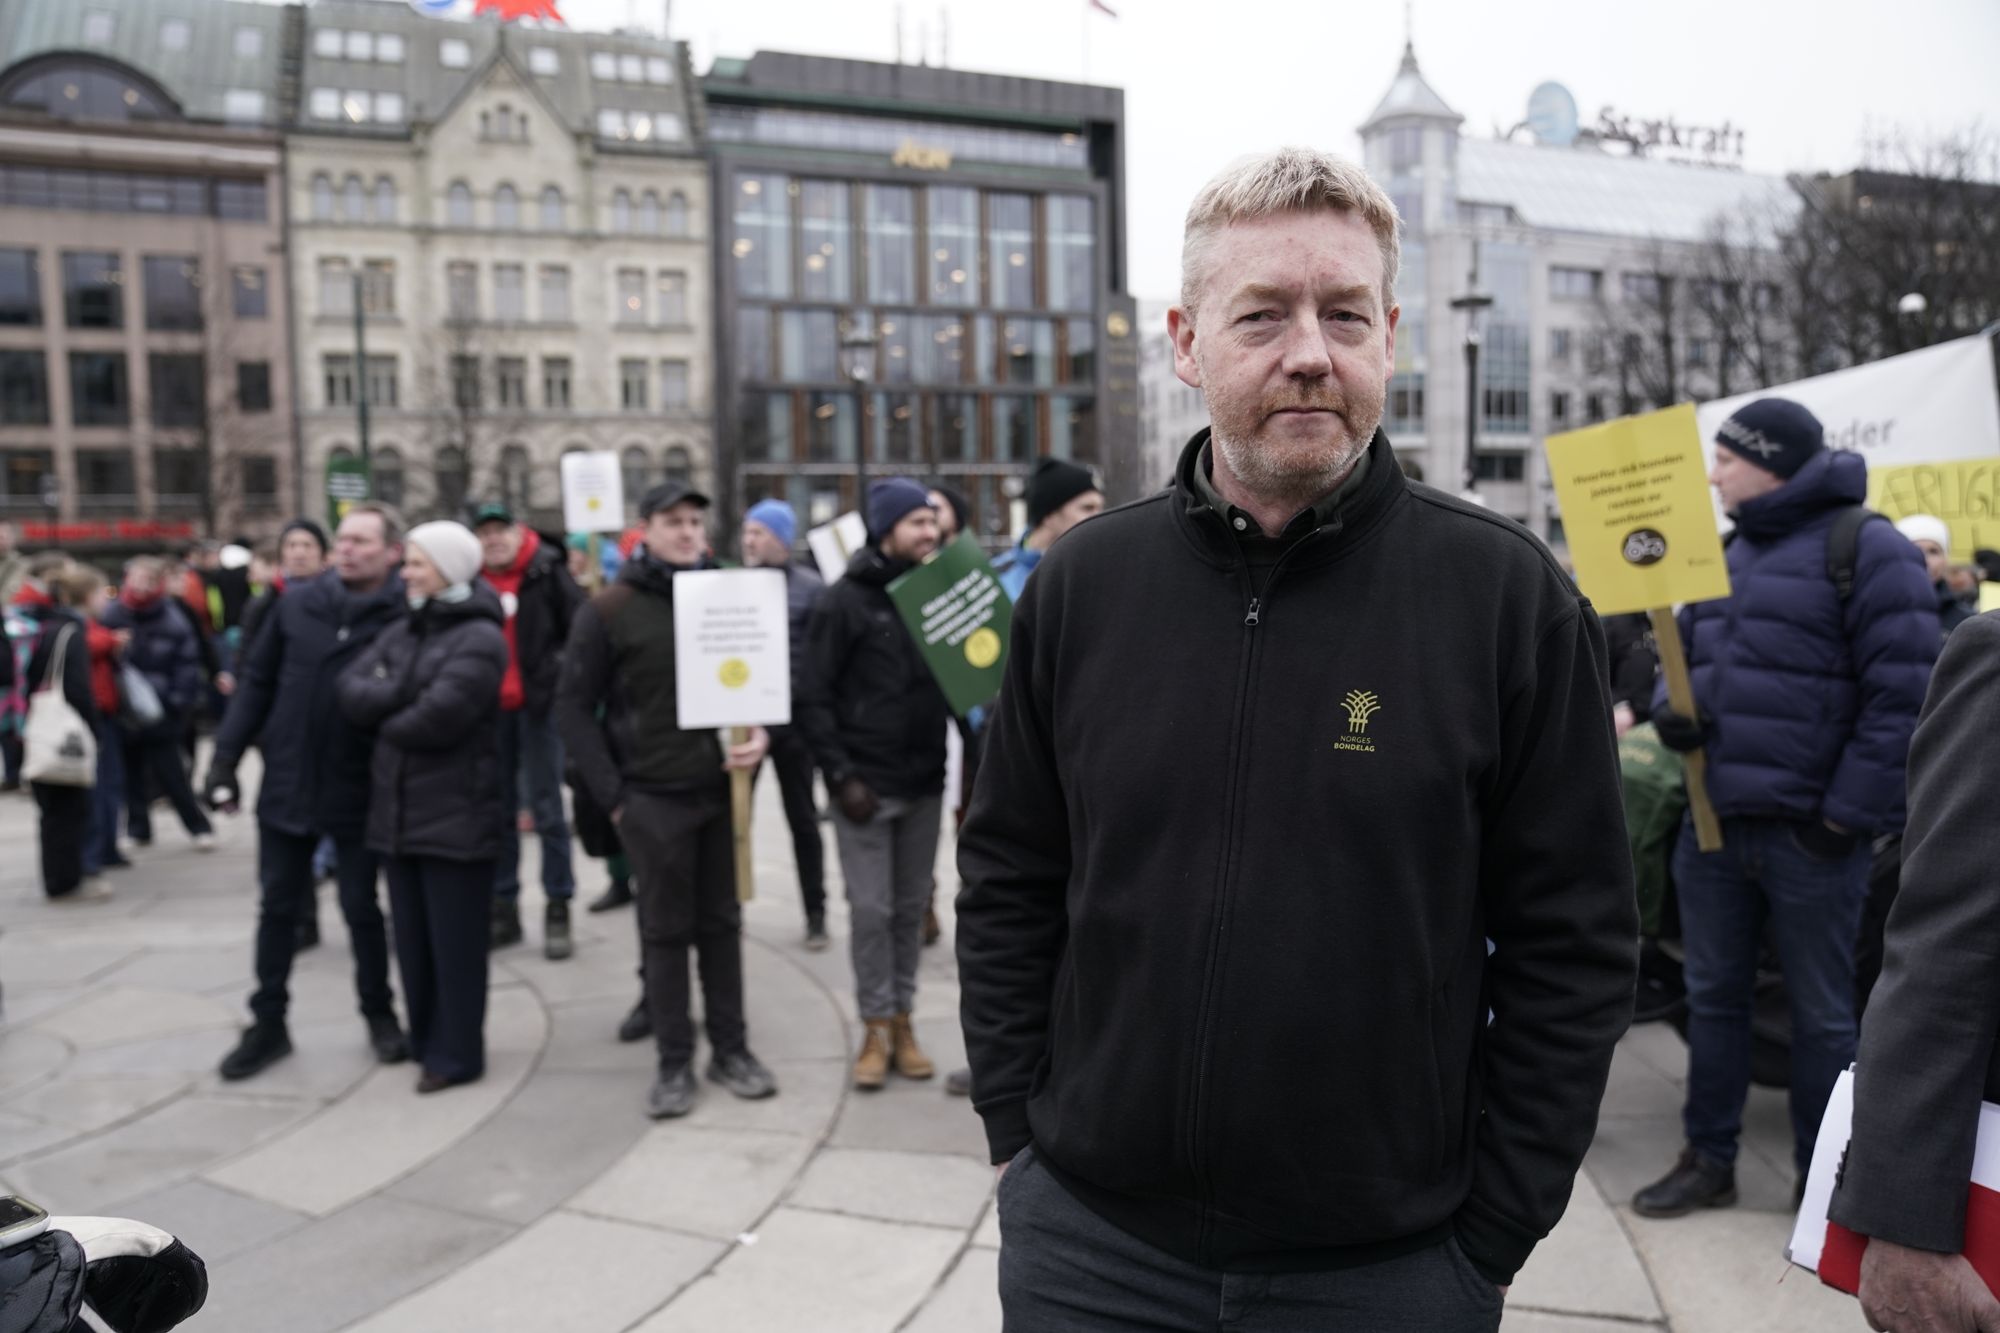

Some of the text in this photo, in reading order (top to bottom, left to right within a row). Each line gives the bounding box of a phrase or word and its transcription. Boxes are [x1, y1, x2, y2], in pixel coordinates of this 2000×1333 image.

[1619, 463, 1638, 477] må
[1639, 453, 1684, 471] bonden
[1340, 735, 1371, 744] NORGES
[1333, 742, 1375, 752] BONDELAG
